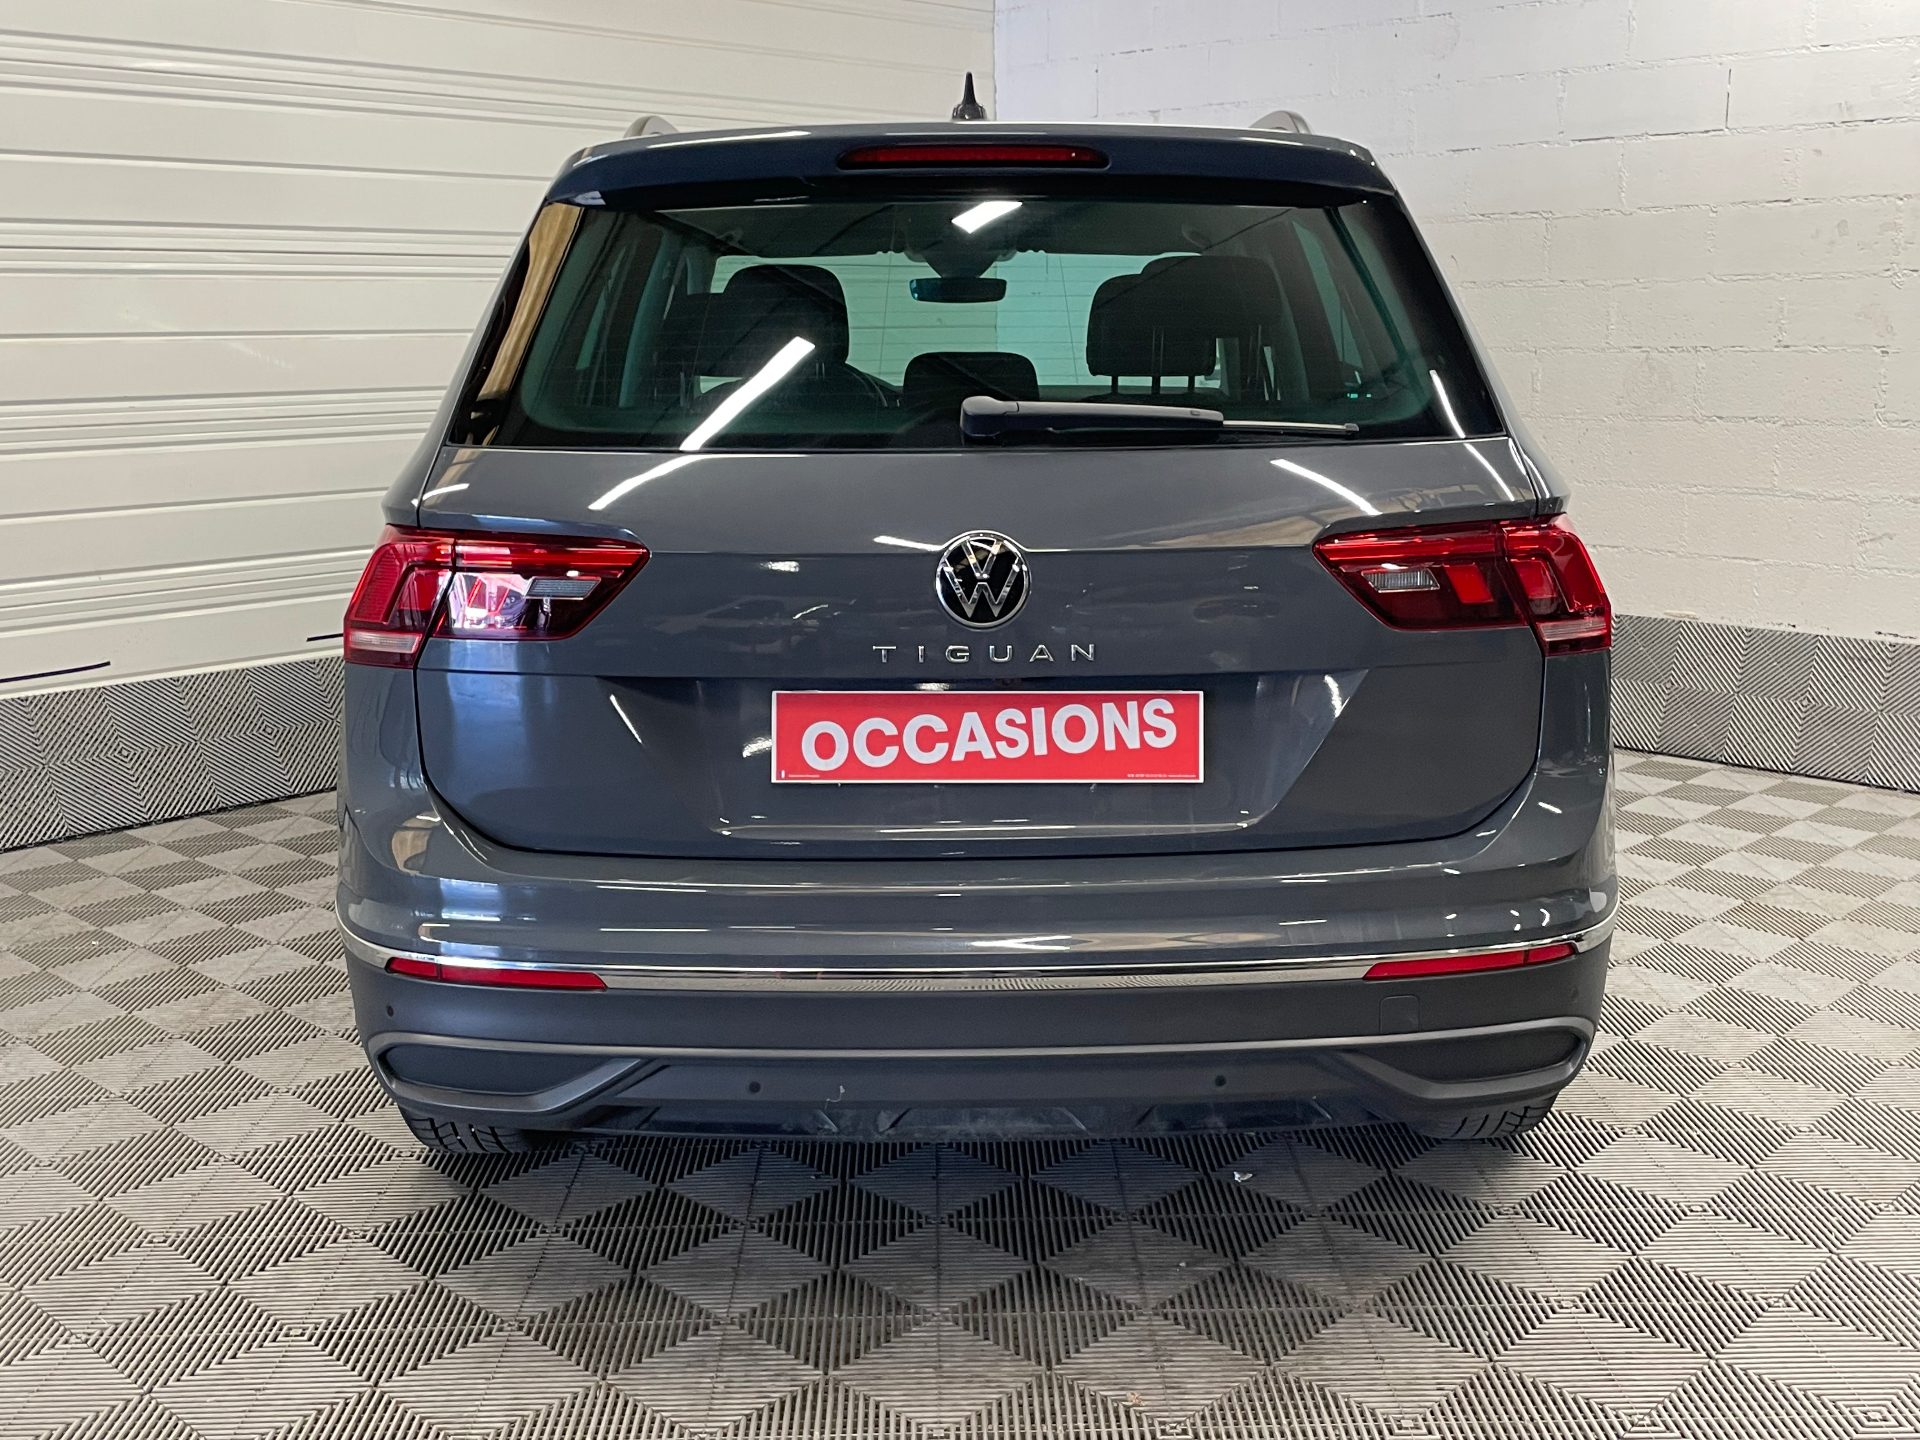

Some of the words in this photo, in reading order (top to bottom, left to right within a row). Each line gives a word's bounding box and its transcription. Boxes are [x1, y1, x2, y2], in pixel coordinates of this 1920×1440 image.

[941, 535, 1026, 620] VW
[873, 643, 1096, 663] TIGUAN
[801, 698, 1177, 771] OCCASIONS
